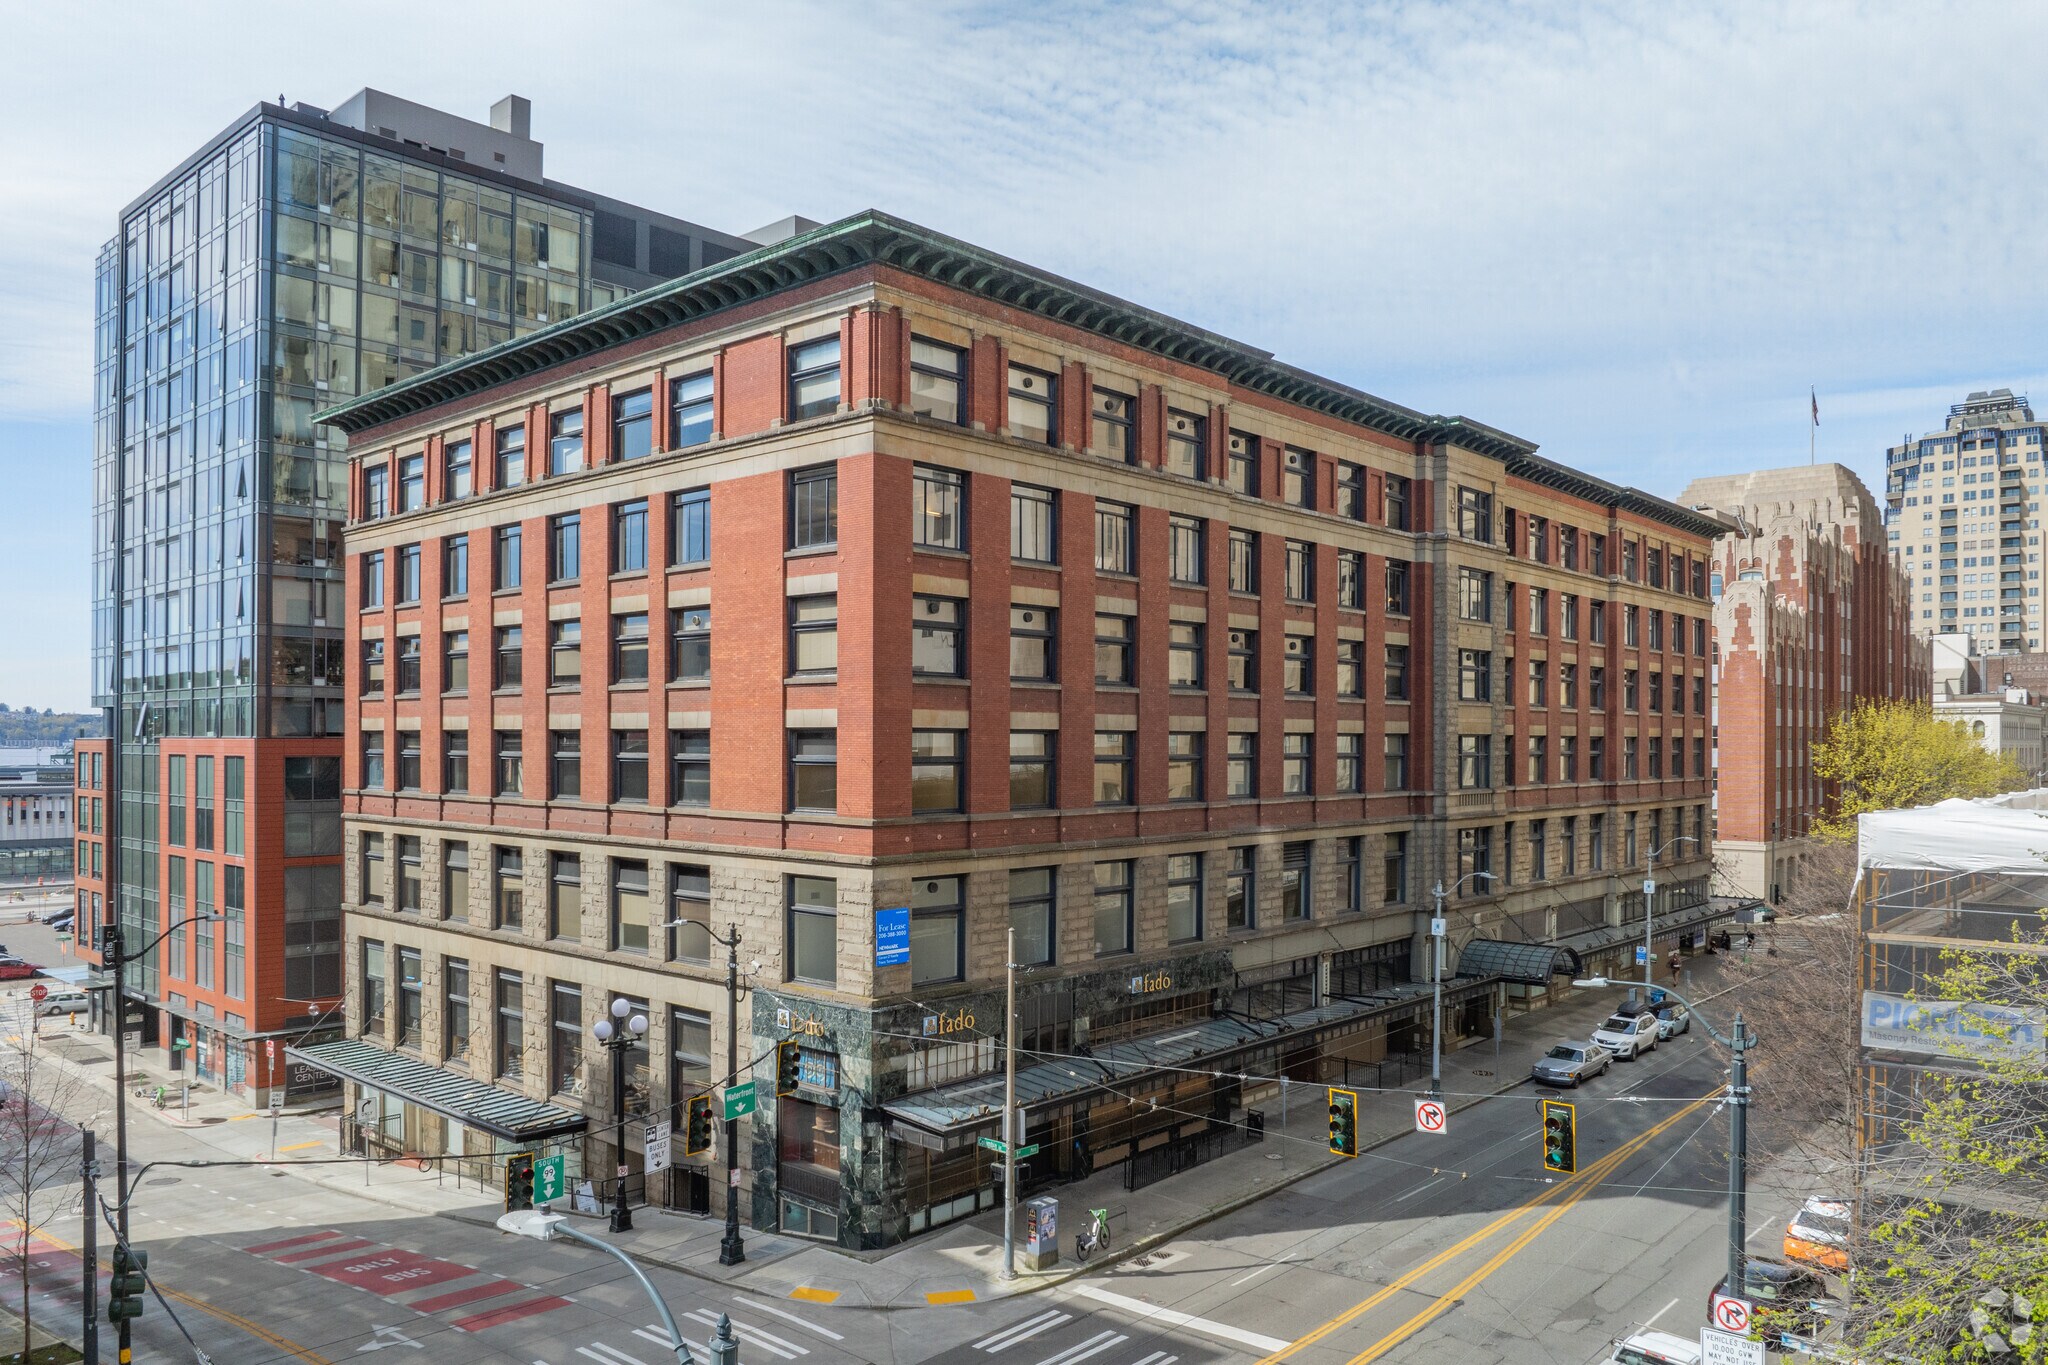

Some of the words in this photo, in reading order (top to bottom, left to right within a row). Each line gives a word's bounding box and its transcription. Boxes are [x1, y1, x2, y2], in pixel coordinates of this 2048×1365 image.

[879, 924, 889, 932] For
[1144, 970, 1171, 993] fadó
[939, 1008, 975, 1035] fadó
[1869, 1031, 1909, 1044] Masonry
[295, 1070, 331, 1083] CENTER
[726, 1087, 754, 1102] Waterfront
[649, 1141, 667, 1152] BUSES
[651, 1150, 665, 1160] ONLY
[538, 1157, 559, 1167] SOUTH
[544, 1168, 553, 1177] 99
[344, 1257, 400, 1273] ONLY
[382, 1268, 432, 1282] BUS
[1706, 1333, 1738, 1346] VEHICLES
[1741, 1340, 1760, 1352] OVER
[1708, 1352, 1721, 1360] MAY
[1726, 1356, 1739, 1364] NOT
[1739, 1350, 1753, 1359] GVW
